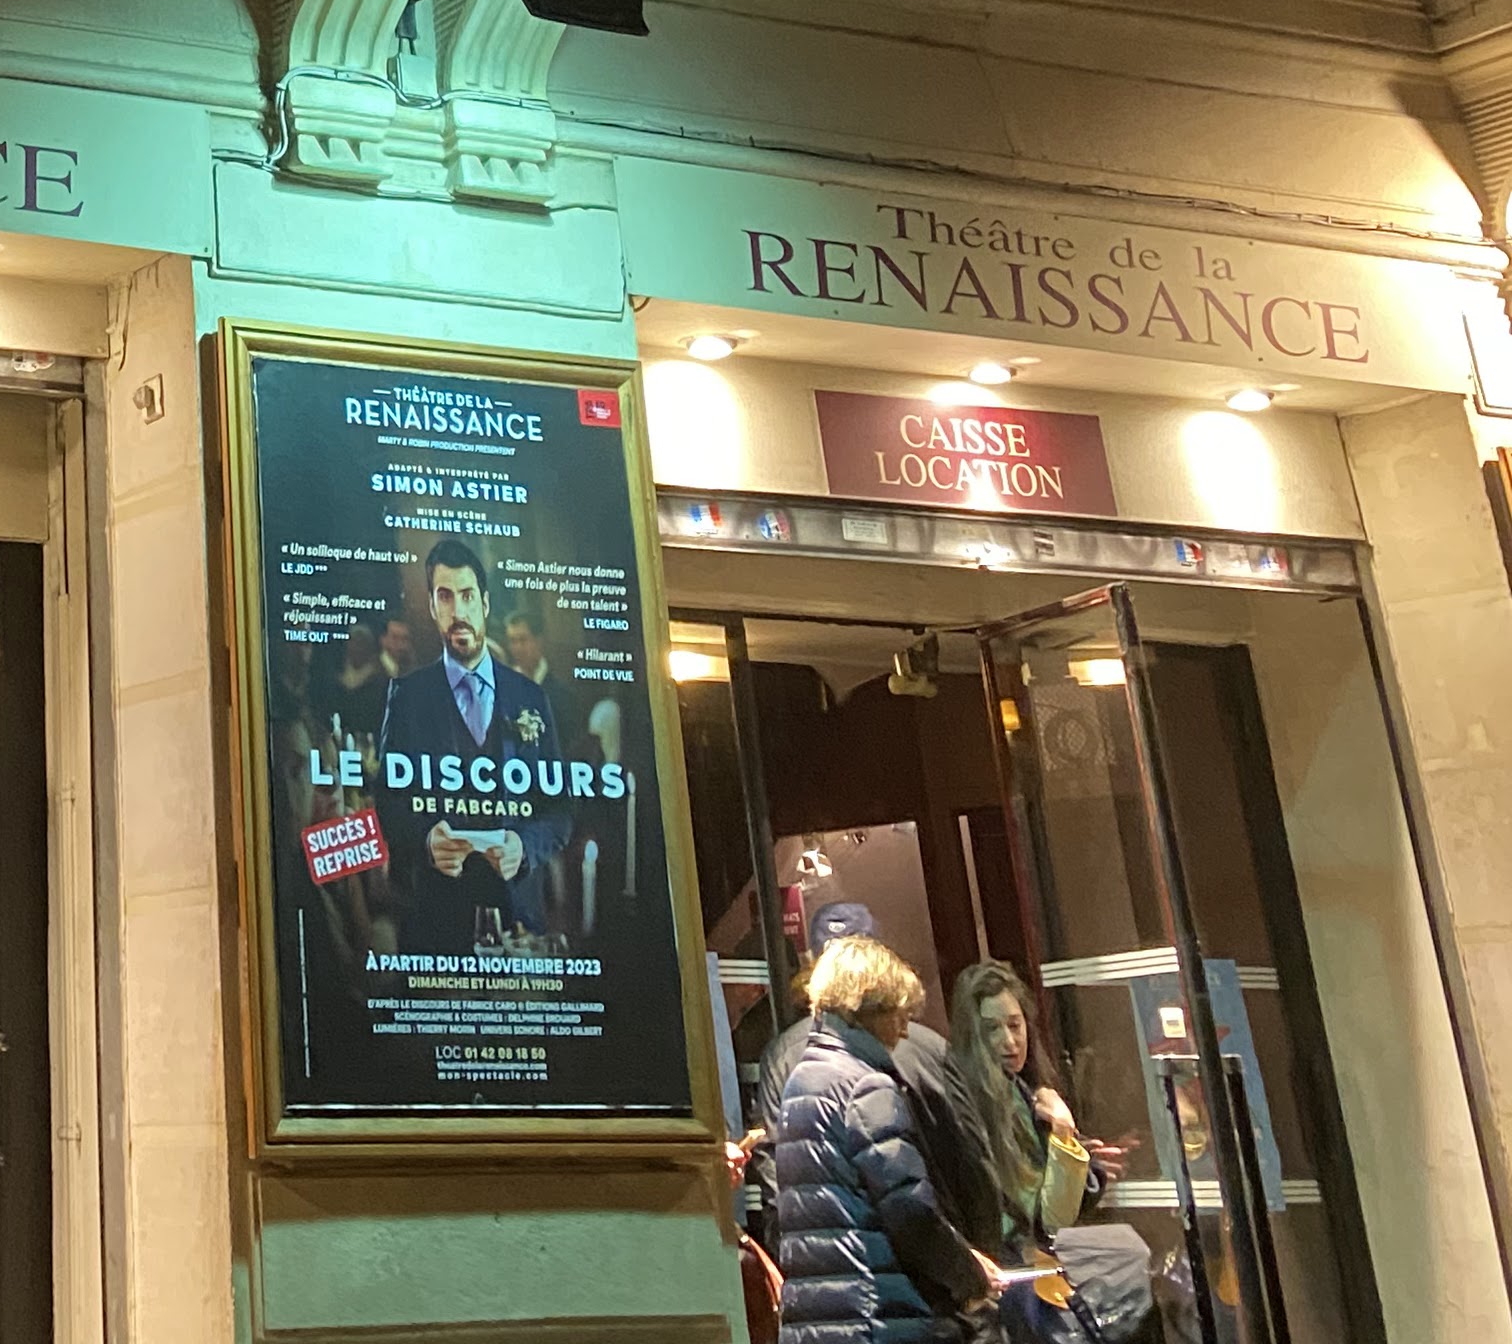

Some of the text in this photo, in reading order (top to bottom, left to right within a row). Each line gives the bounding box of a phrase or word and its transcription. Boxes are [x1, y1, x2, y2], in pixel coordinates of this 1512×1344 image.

[876, 204, 1236, 282] Théâtre de la
[742, 229, 1371, 366] RENAISSANCE
[456, 394, 474, 407] DE
[475, 395, 494, 410] LA
[345, 397, 544, 442] RENAISSANCE
[900, 415, 1032, 459] CAISSE
[874, 450, 1064, 502] LOCATION
[371, 473, 529, 504] SIMON ASTIER
[384, 514, 521, 538] CATHERINE SCHAUB
[290, 542, 305, 556] Un
[354, 547, 367, 560] de
[368, 548, 392, 563] haut
[281, 563, 314, 575] LE JDD
[505, 559, 625, 580] Simon Astier nous donne
[504, 577, 627, 597] une fois de plus la preuve
[331, 594, 373, 610] efficace
[374, 597, 386, 611] et
[556, 596, 619, 613] de son talent
[283, 609, 343, 626] réjouissant
[583, 618, 630, 631] LE FIGARO
[284, 630, 330, 643] TIME OUT
[585, 648, 625, 664] Hilarant
[574, 667, 635, 682] POINT DE VUE
[310, 750, 628, 799] LE DISCOURS
[412, 797, 533, 817] DE FABCARO
[307, 821, 367, 854] SUCCÈS
[313, 840, 382, 878] REPRISE
[366, 950, 602, 976] À PARTIR DU 12 NOVEMBRE 2023
[408, 976, 470, 990] DIMANCHE
[471, 977, 485, 990] ET
[486, 977, 520, 991] LUNDI
[531, 978, 564, 992] 19H30
[436, 1045, 462, 1060] LOC
[464, 1047, 478, 1060] 01
[480, 1047, 496, 1060] 42
